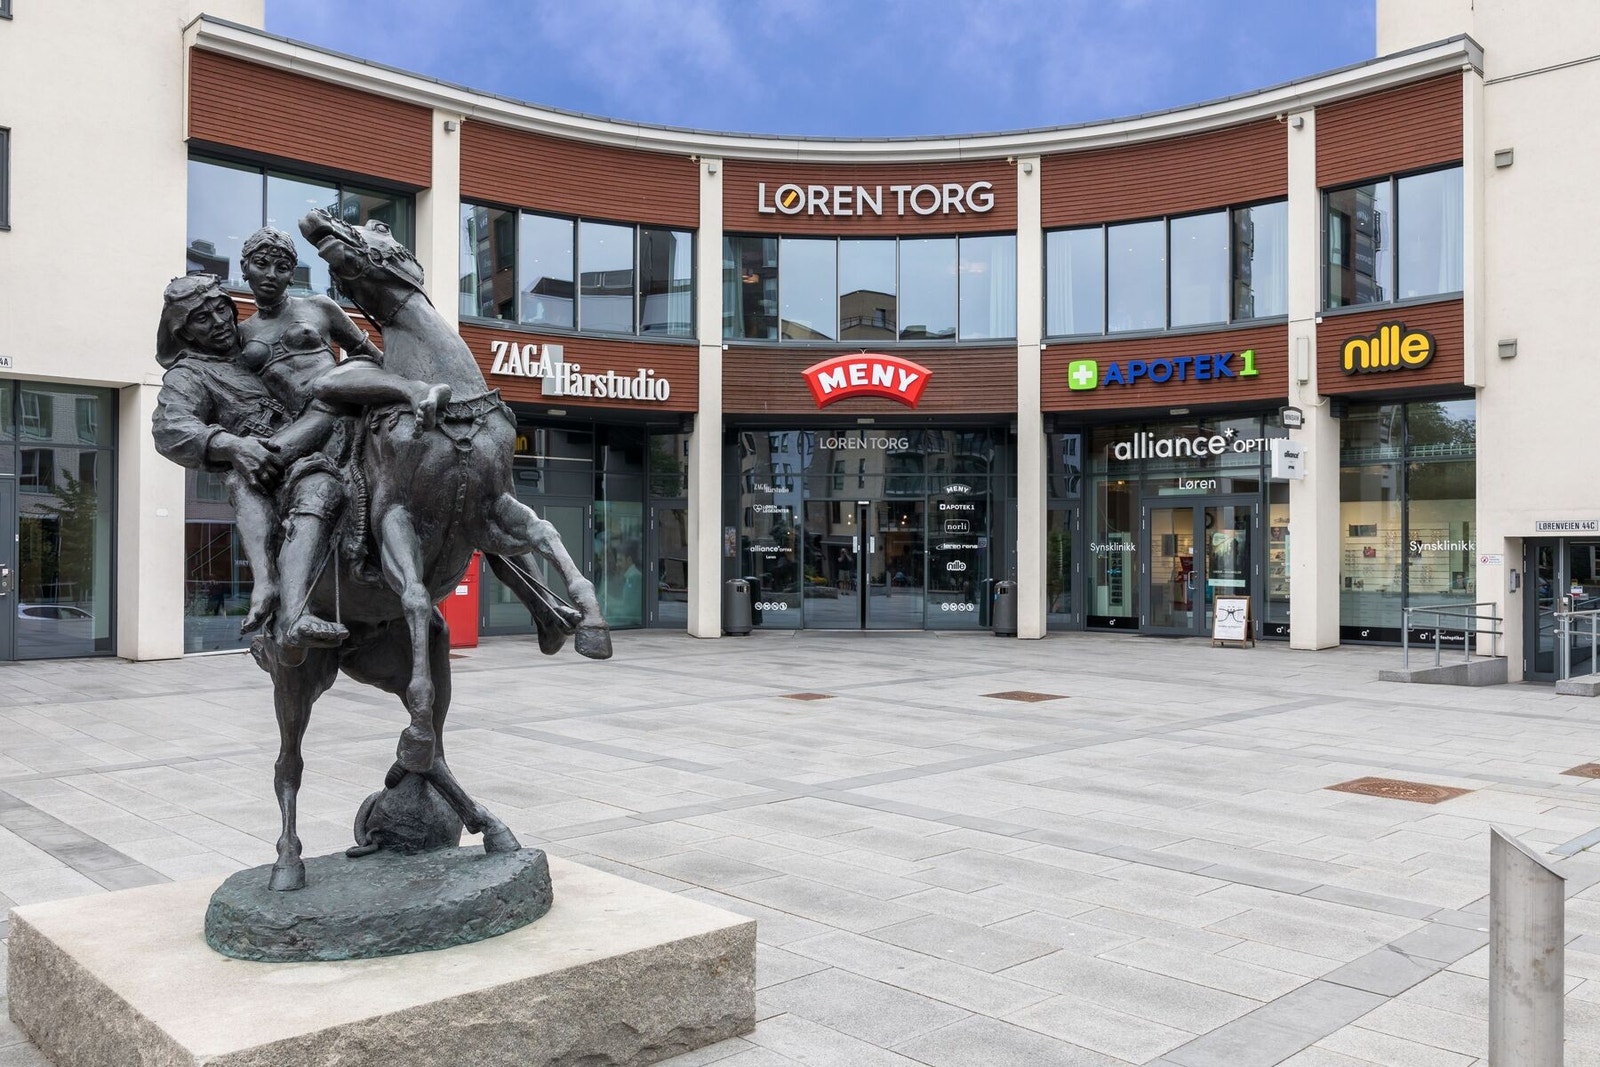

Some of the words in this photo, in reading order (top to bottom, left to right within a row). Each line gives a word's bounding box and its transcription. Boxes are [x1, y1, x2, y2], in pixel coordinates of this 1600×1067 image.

[890, 181, 995, 215] TORG
[1343, 325, 1431, 370] nille
[490, 340, 555, 379] ZAGA
[554, 363, 671, 401] Hårstudio
[1103, 352, 1236, 386] APOTEK
[1239, 350, 1259, 376] 1
[817, 363, 919, 394] MENY
[870, 437, 909, 450] TORG
[946, 485, 969, 494] MENY
[1179, 477, 1217, 490] Løren
[947, 522, 967, 530] norli
[1538, 522, 1580, 530] LØRENVEIEN
[1581, 521, 1596, 530] 44C
[1090, 542, 1136, 554] Synsklinikk
[1409, 540, 1476, 553] Synsklinikk
[946, 560, 967, 571] nille
